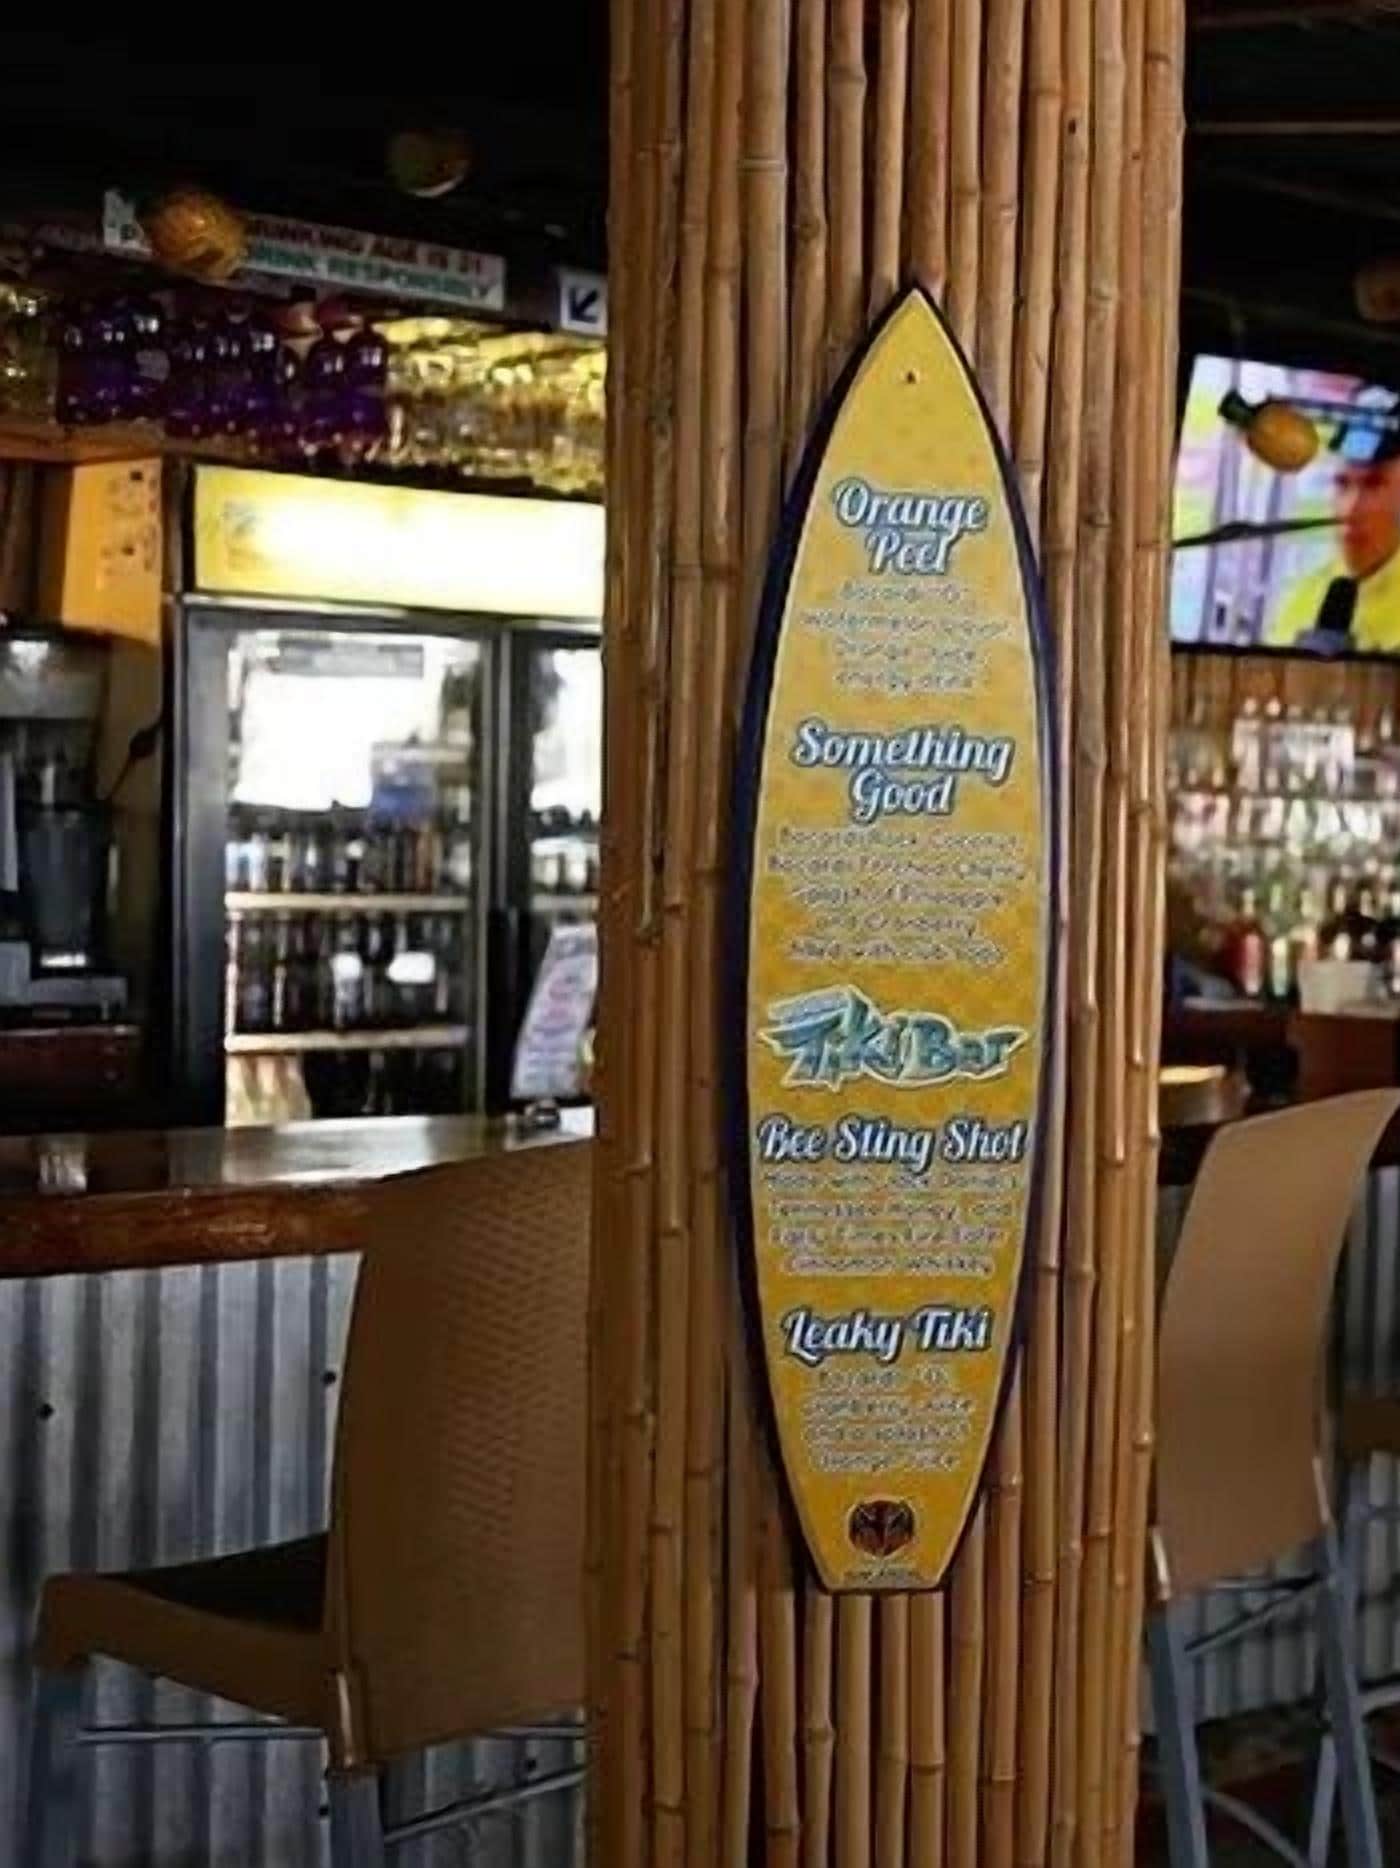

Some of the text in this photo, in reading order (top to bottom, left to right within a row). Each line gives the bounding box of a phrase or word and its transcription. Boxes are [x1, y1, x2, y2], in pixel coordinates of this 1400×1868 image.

[834, 480, 988, 544] Orange
[866, 530, 949, 574] Peel
[794, 717, 1012, 785] Something
[852, 766, 955, 823] Good
[759, 1113, 1028, 1174] Bee Sting Shot
[782, 1305, 993, 1365] Leaky Tiki
